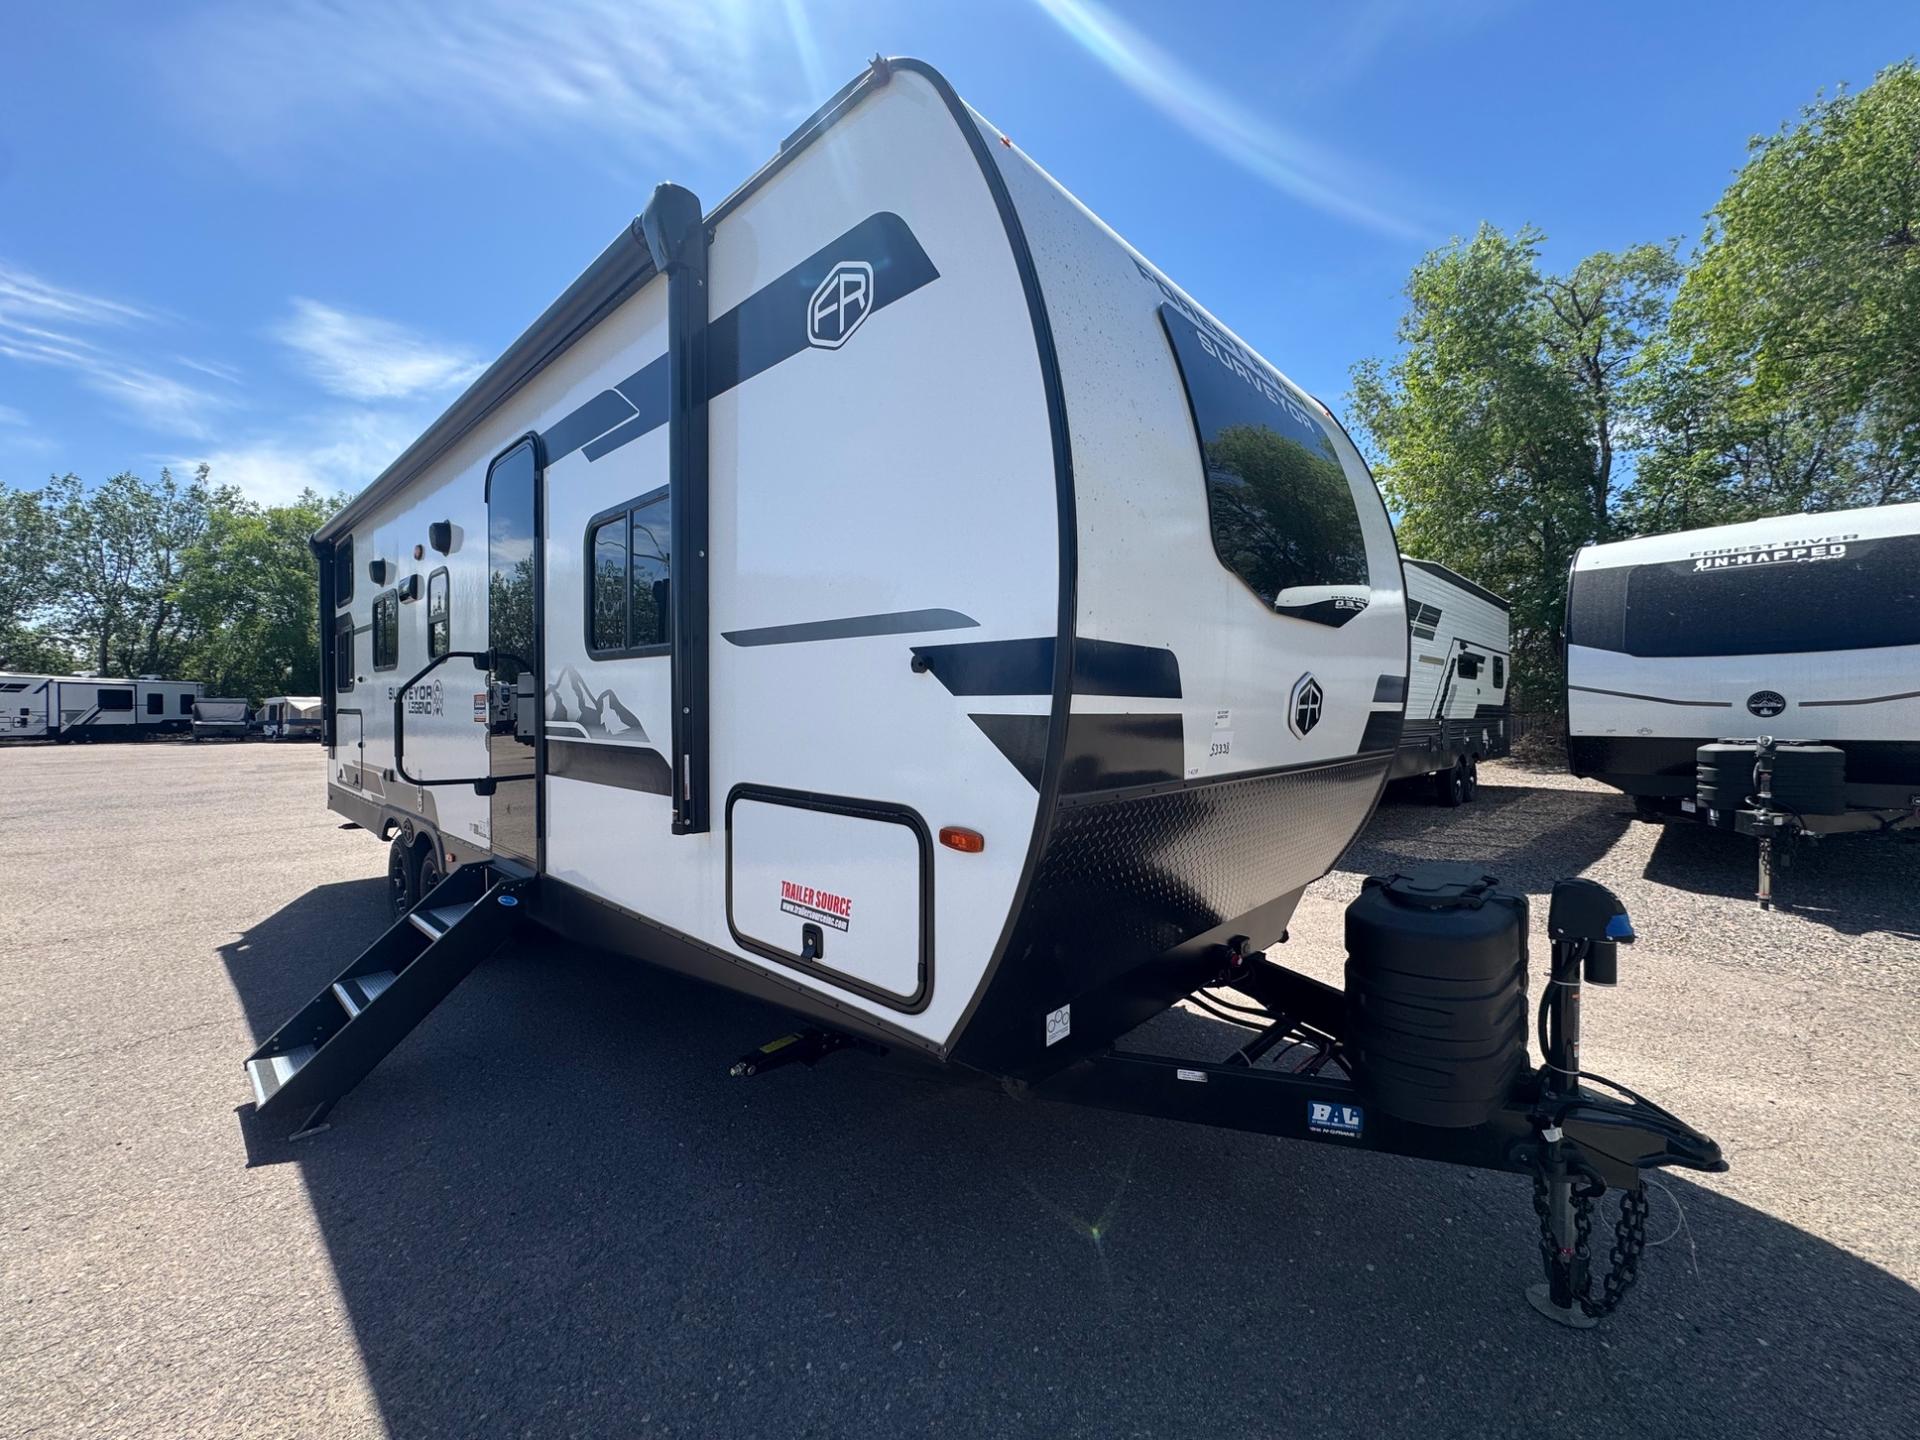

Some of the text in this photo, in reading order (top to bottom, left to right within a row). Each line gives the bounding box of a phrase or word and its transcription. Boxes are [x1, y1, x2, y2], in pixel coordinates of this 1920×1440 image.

[1196, 330, 1316, 434] SURVEYOR
[1690, 534, 1859, 557] FOREST RIVER
[388, 685, 433, 701] SUEYOR
[781, 880, 852, 917] TRAILER SOURCE
